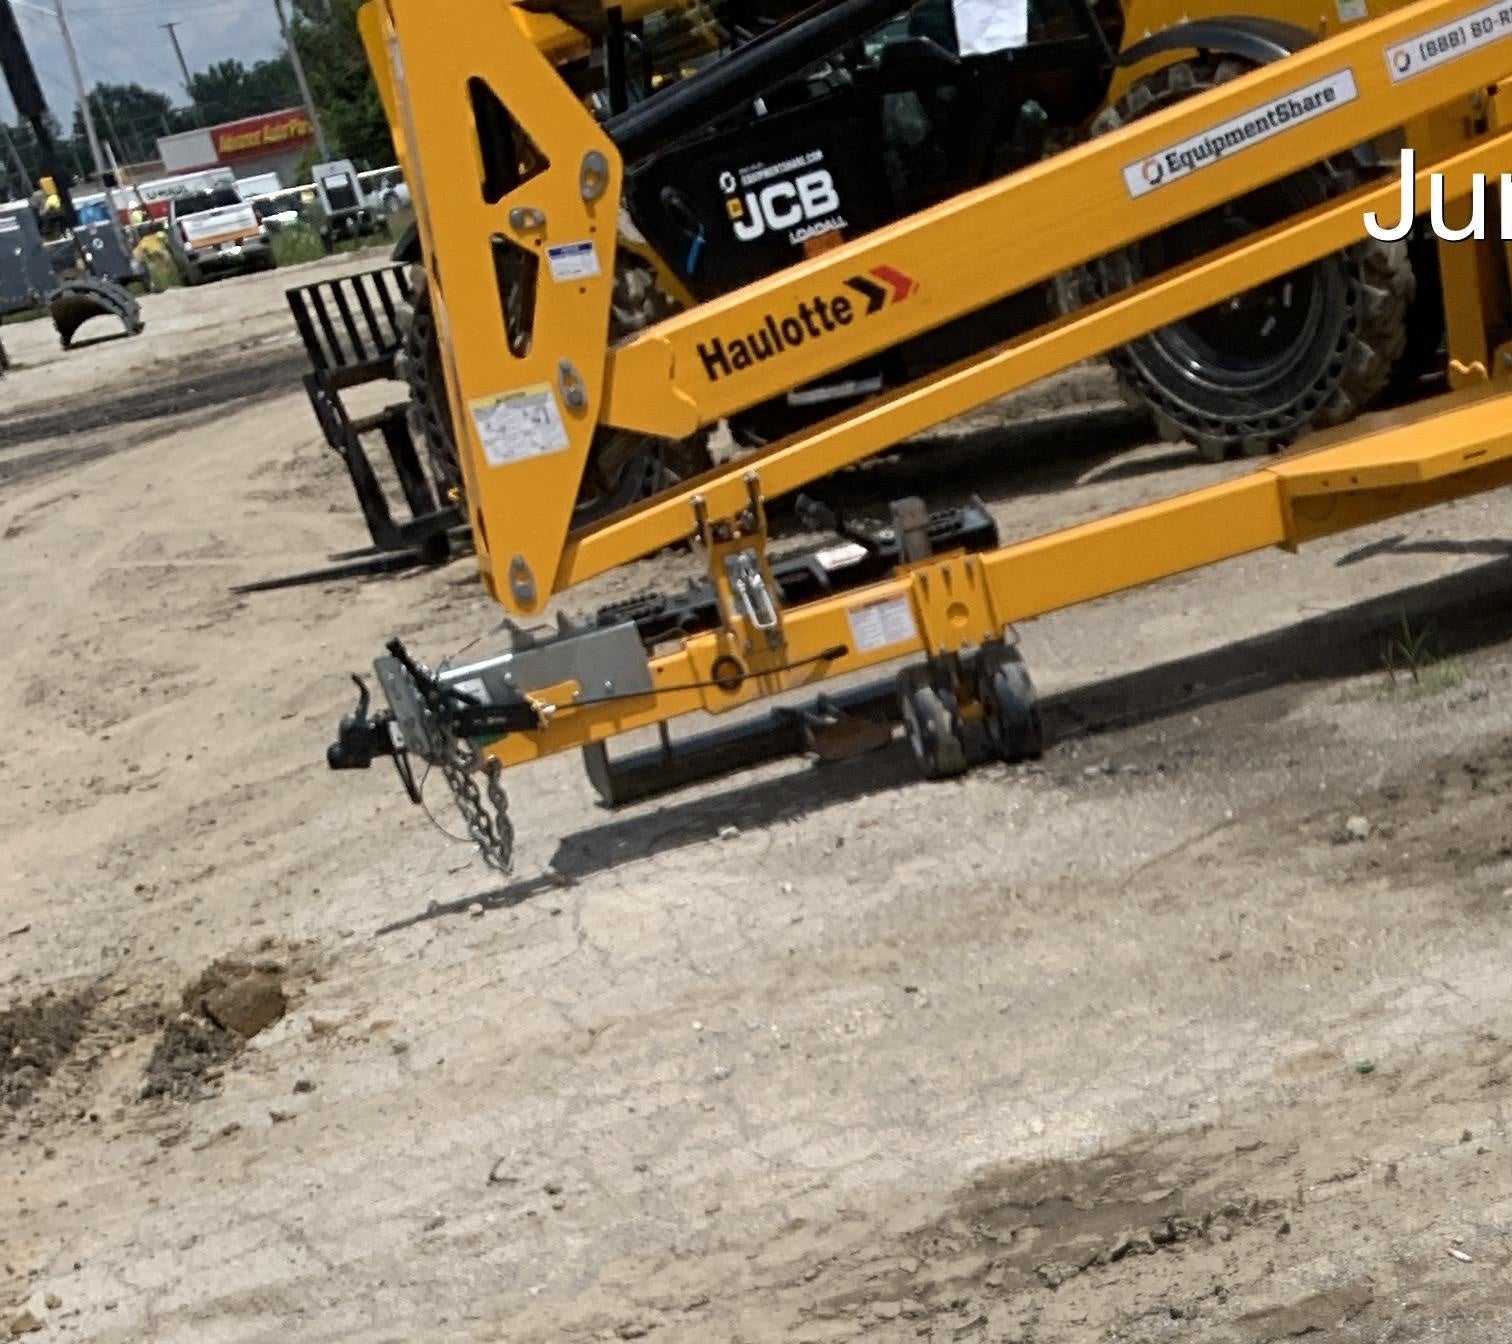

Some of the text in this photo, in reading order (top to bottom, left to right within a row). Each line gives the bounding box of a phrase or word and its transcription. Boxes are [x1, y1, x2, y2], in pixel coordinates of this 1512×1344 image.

[1418, 27, 1466, 61] (888)
[1164, 86, 1337, 174] EquipmentShare
[732, 169, 840, 241] JCB
[696, 295, 854, 382] Haulotte
